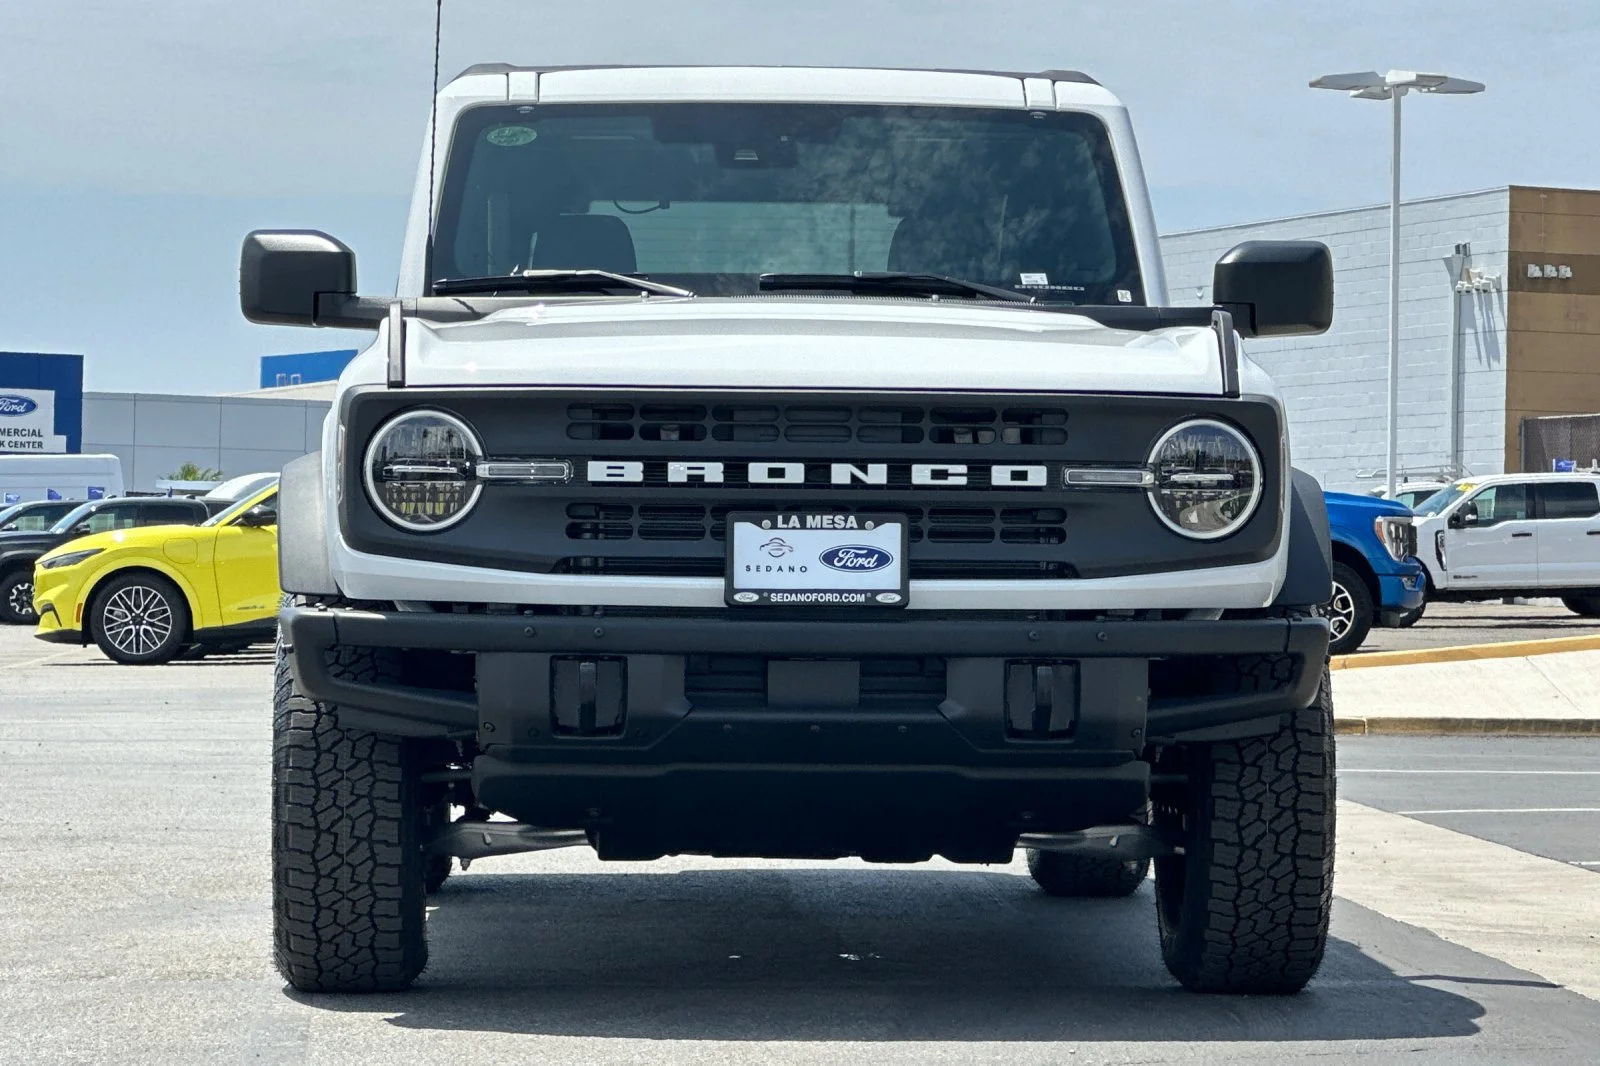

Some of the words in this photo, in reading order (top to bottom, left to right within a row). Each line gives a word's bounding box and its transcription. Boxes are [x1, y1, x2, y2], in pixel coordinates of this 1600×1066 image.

[0, 398, 27, 412] Ford
[8, 441, 44, 449] CENTER
[587, 461, 1047, 486] BRONCO
[777, 515, 800, 529] LA
[806, 515, 858, 529] MESA
[833, 548, 878, 568] Ford
[745, 565, 808, 573] SEDANO
[770, 592, 865, 603] SEDANOFORD.COM
